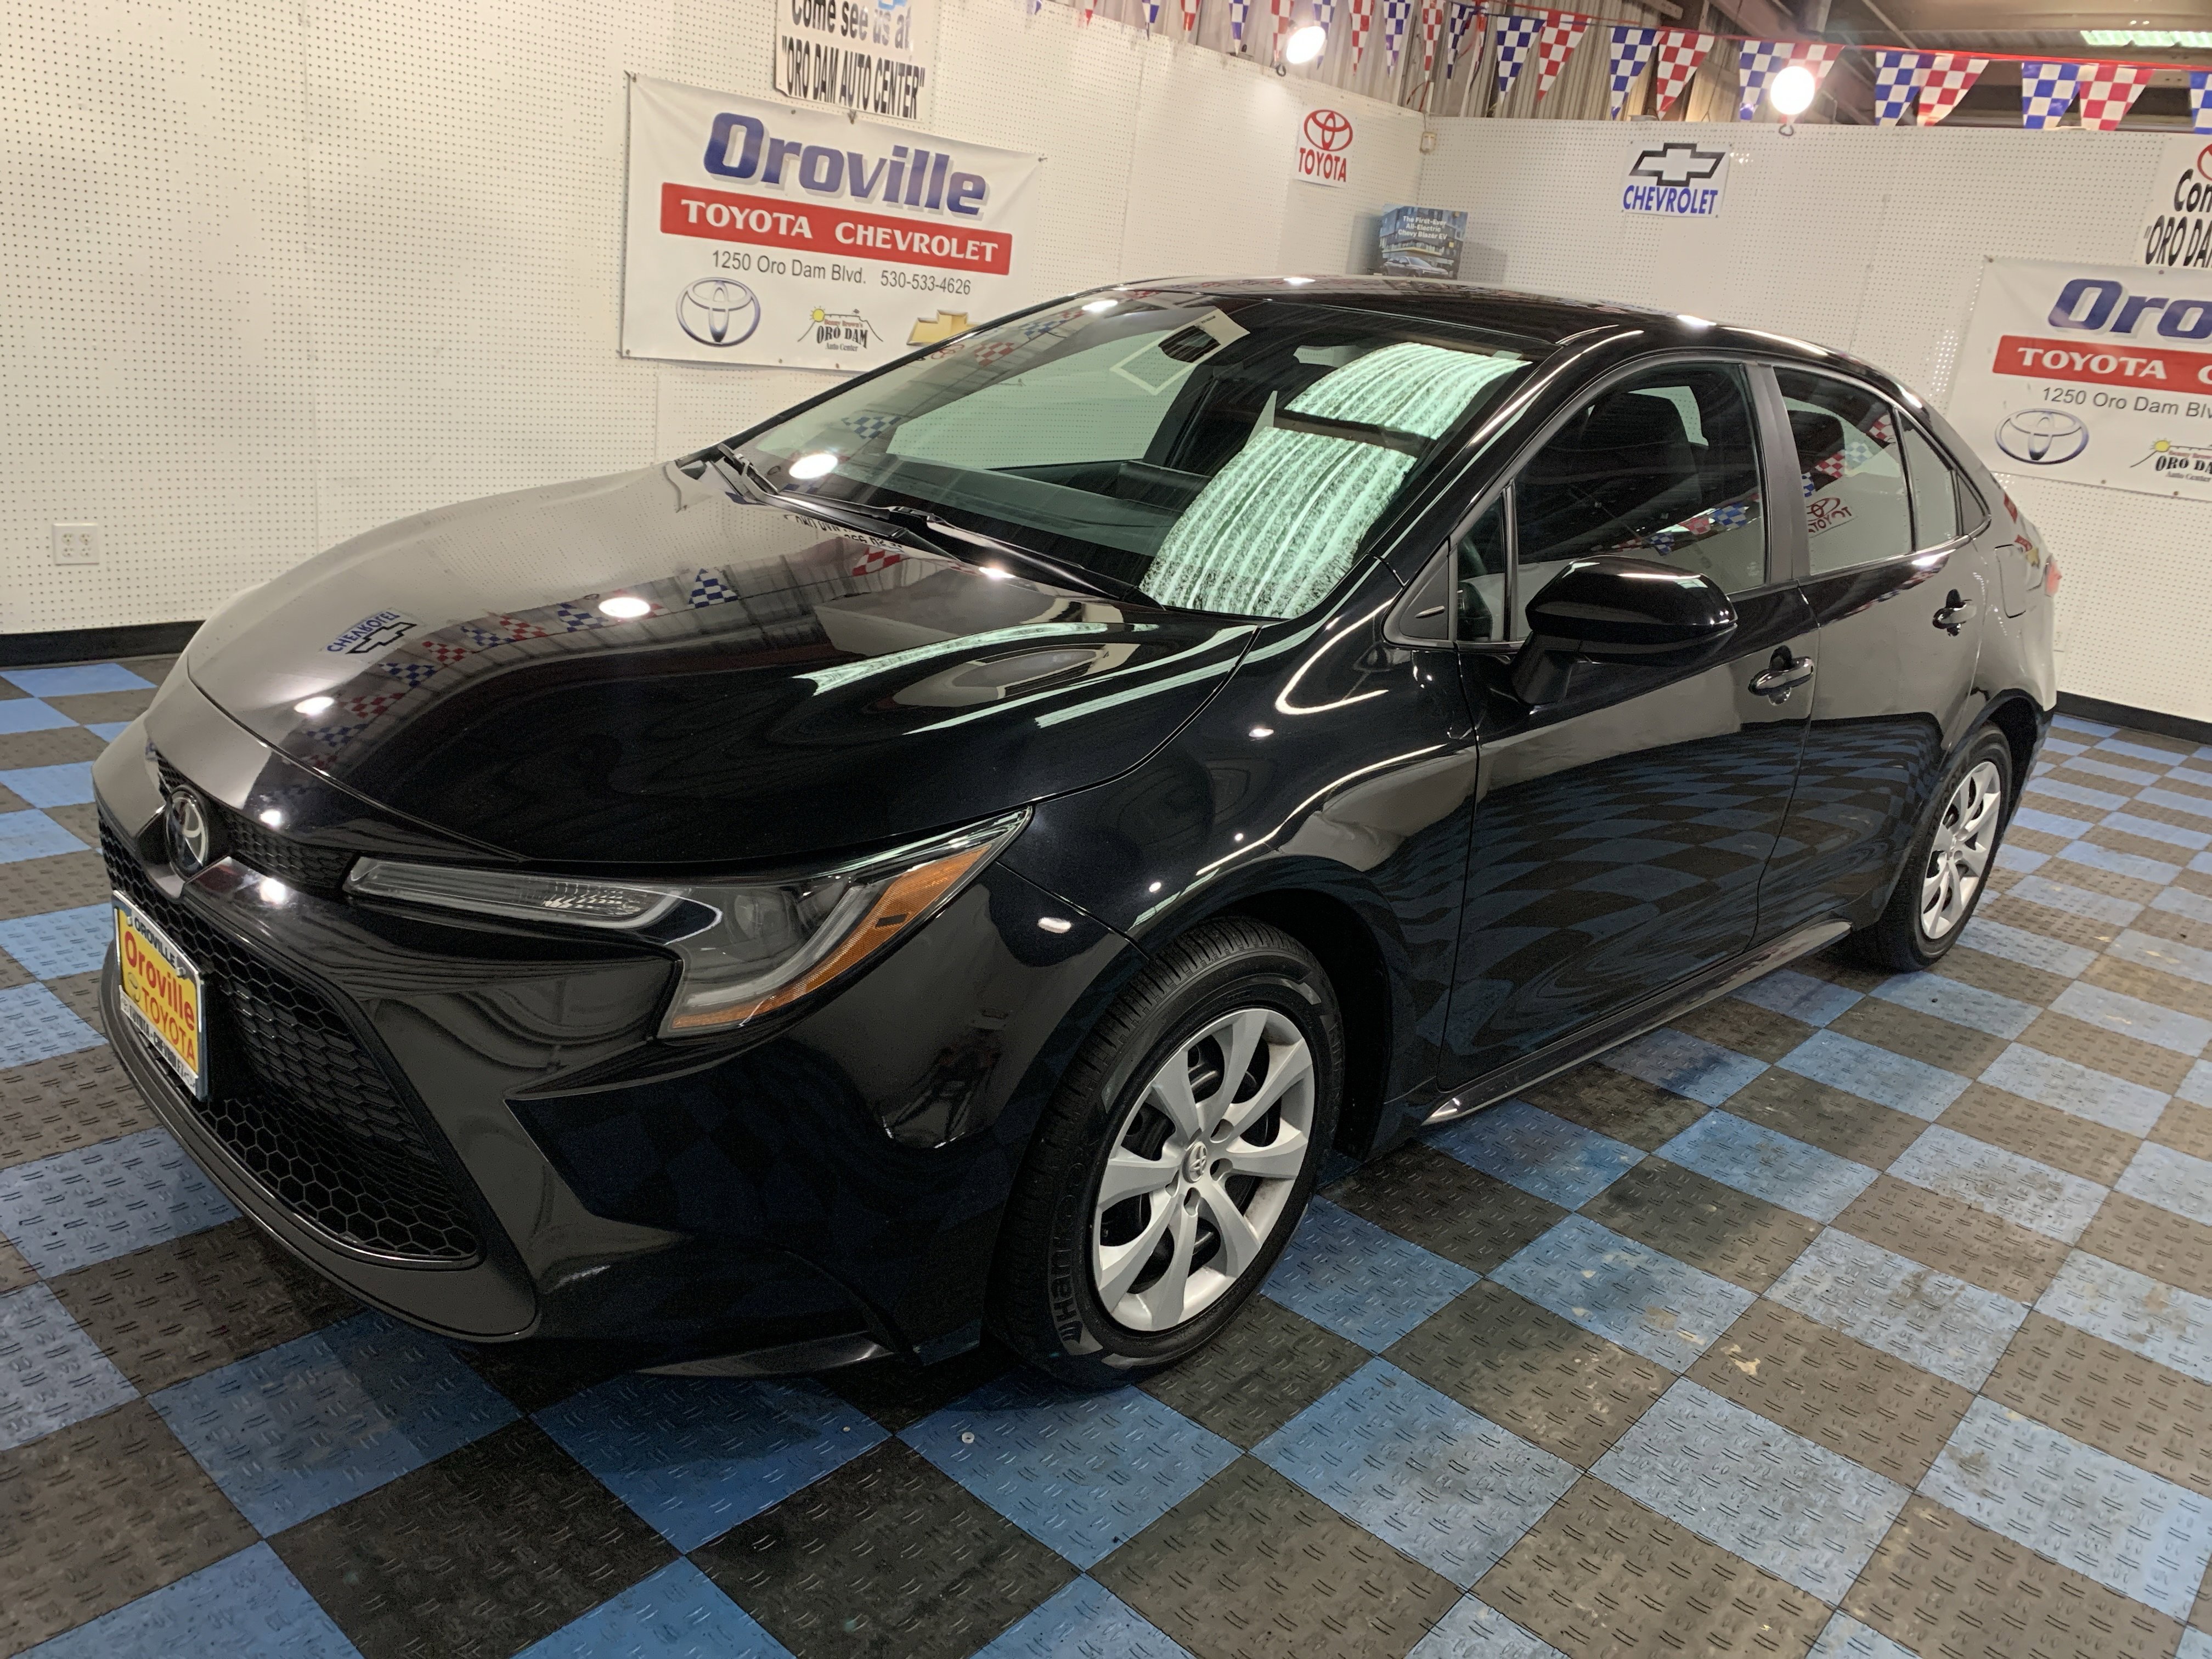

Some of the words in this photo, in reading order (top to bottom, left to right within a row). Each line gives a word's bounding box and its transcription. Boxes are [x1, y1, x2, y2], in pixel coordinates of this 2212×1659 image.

[841, 1, 868, 41] see
[873, 9, 891, 46] us
[895, 5, 911, 50] at
[782, 35, 810, 99] "ORO
[813, 43, 839, 104] DAM
[839, 50, 871, 110] AUTO
[873, 57, 926, 120] CENTER"
[703, 112, 988, 216] Oroville
[1298, 147, 1347, 183] TOYOTA
[1622, 184, 1719, 215] CHEVROLET
[681, 199, 813, 239] TOYOTA
[834, 222, 998, 263] CHEVROLET
[1398, 229, 1417, 238] Chevy
[1406, 223, 1441, 233] All-Electric
[1415, 217, 1447, 226] First-Ever
[712, 249, 751, 271] 1250
[757, 255, 786, 276] Oro
[792, 259, 826, 280] Dam
[832, 263, 866, 284] Blvd.
[881, 270, 971, 296] 530-533-4626
[816, 326, 841, 344] ORO
[844, 328, 868, 349] DAM
[840, 343, 859, 352] Center
[2017, 347, 2168, 380] TOYOTA
[2043, 387, 2087, 405] 1250
[2093, 392, 2128, 409] Oro
[2134, 396, 2179, 415] Dam
[2155, 455, 2190, 471] ORO
[134, 917, 176, 969] OROVILLE
[125, 930, 195, 1031] Oroville
[142, 986, 196, 1068] TOYOTA
